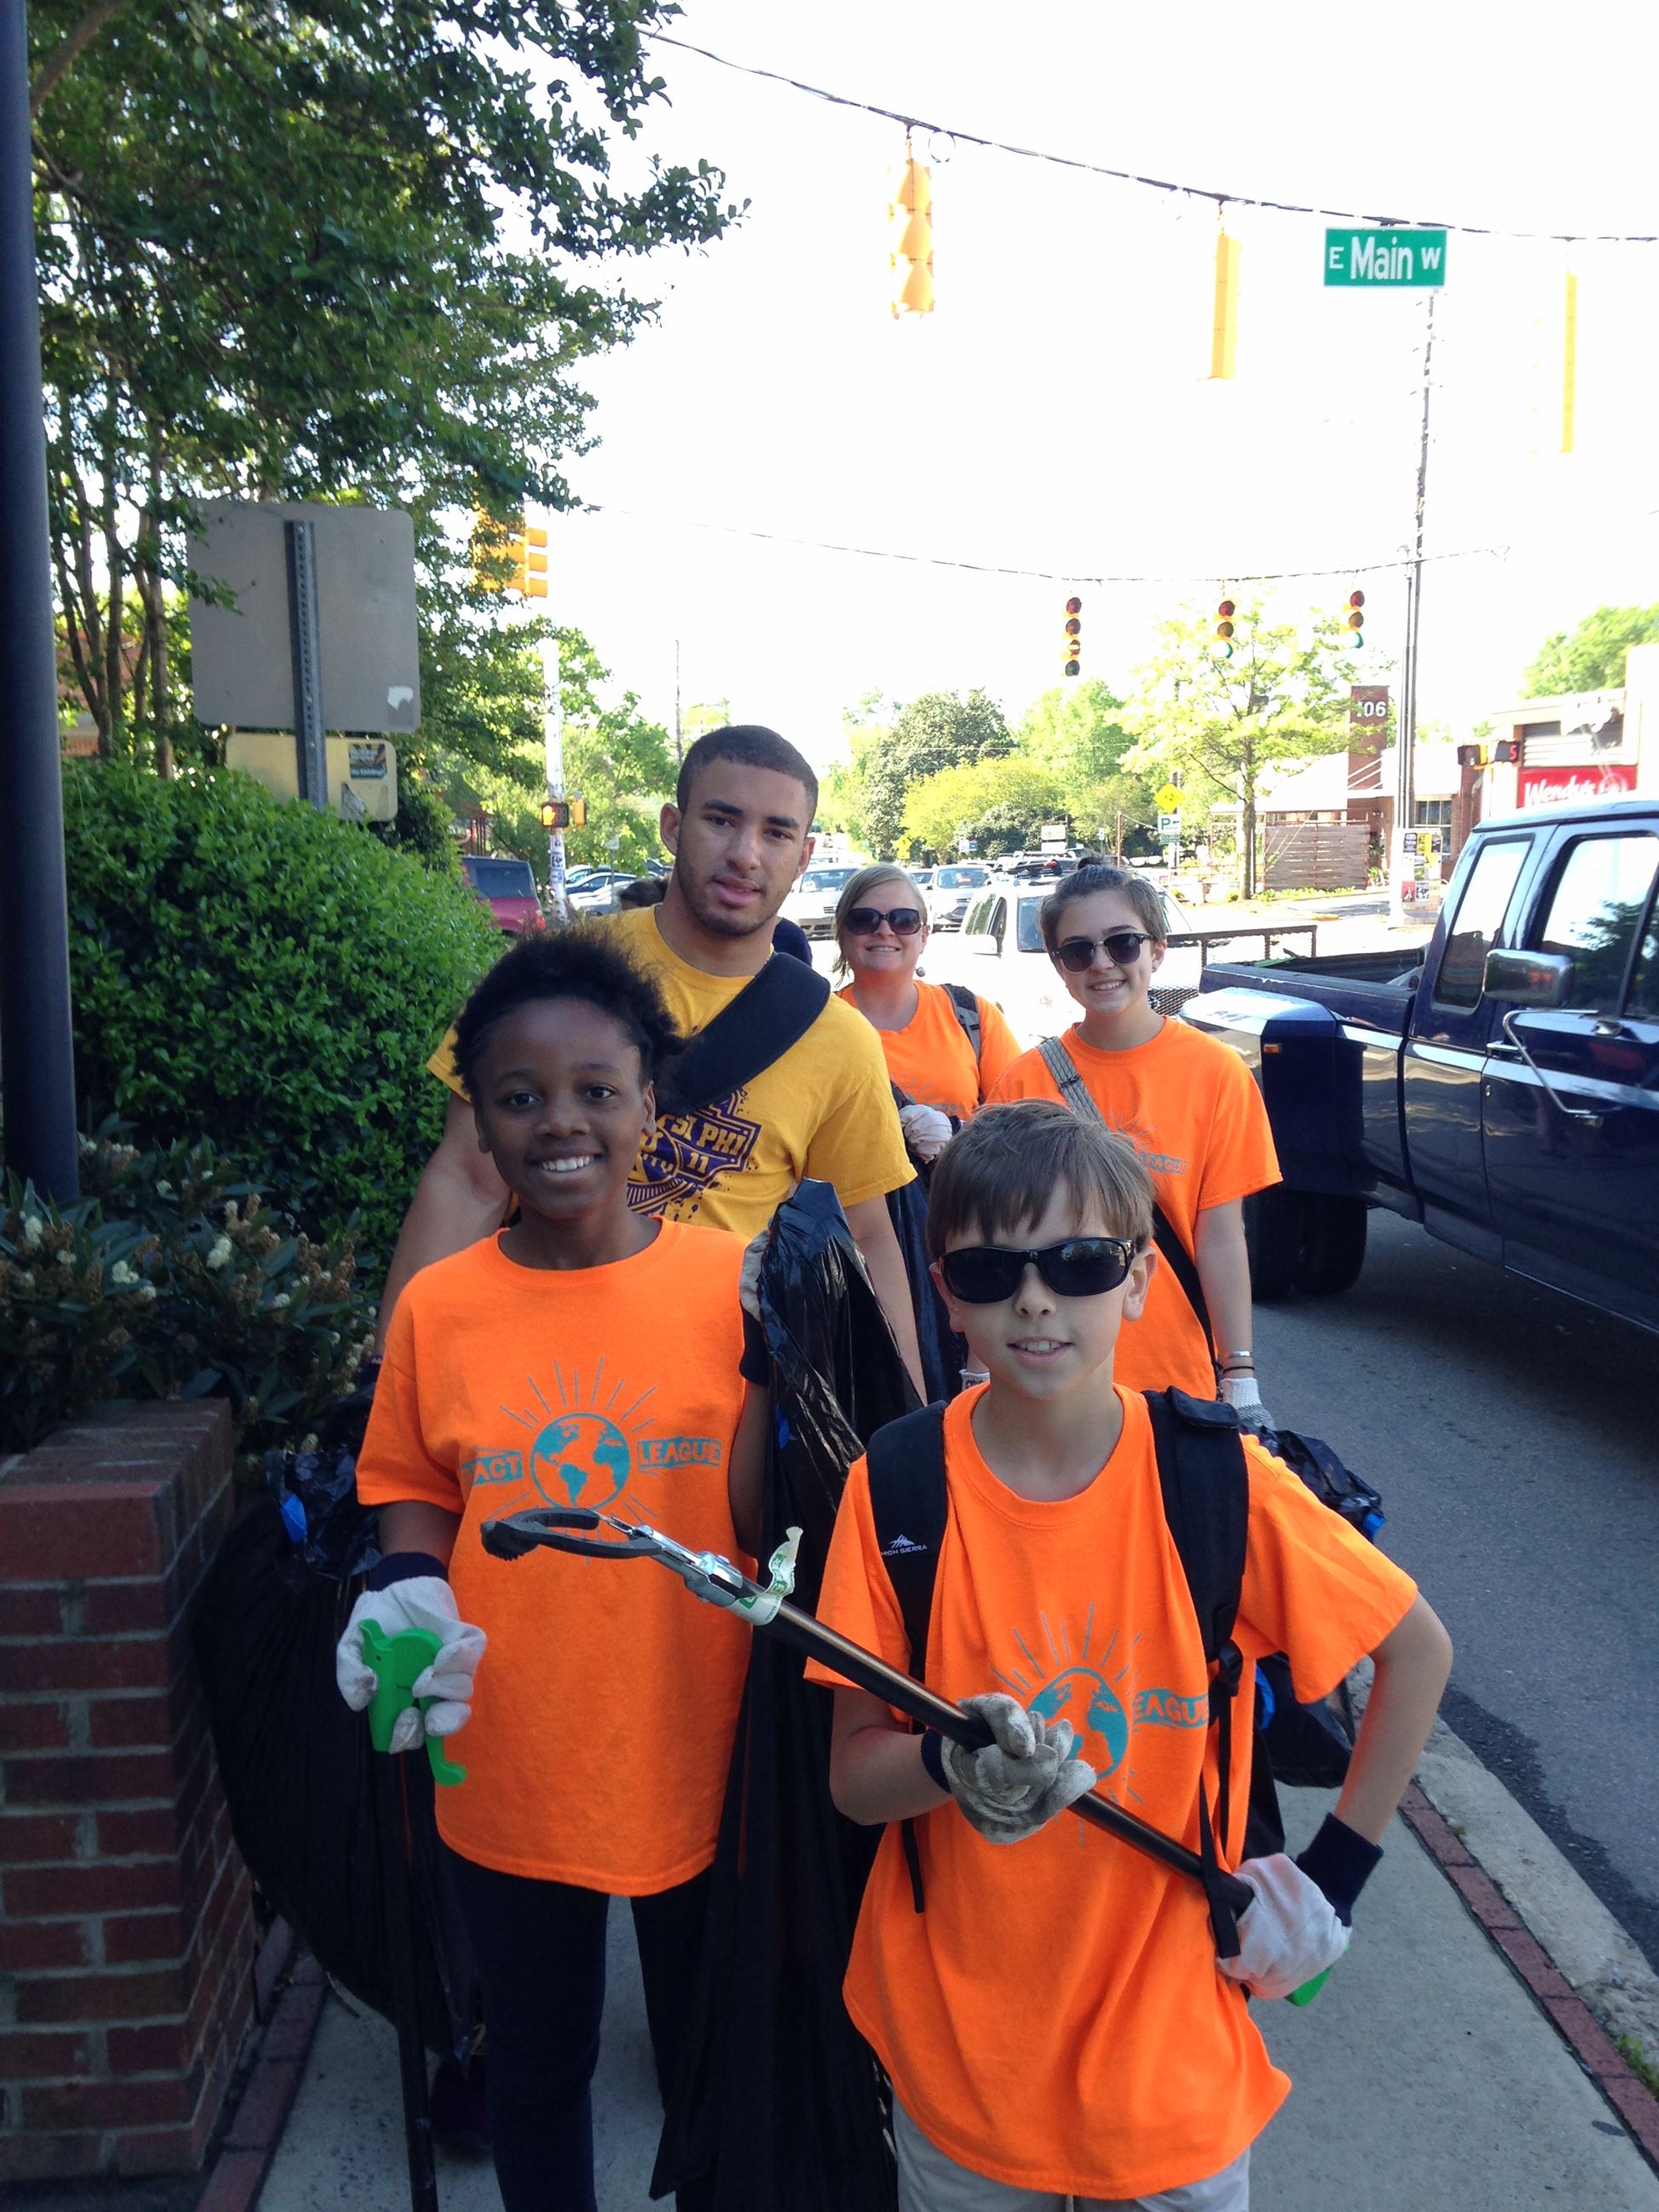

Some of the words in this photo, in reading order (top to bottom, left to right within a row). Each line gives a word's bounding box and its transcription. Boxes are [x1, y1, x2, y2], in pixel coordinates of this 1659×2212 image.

[1329, 247, 1344, 269] E
[1350, 236, 1413, 280] Main
[1421, 247, 1441, 270] W
[1161, 818, 1171, 830] P
[669, 1115, 697, 1141] SI
[696, 1122, 747, 1155] PHI
[1141, 1154, 1189, 1172] EAGUE
[639, 1440, 721, 1465] LEAGUE
[899, 1544, 927, 1554] SIERRA
[1132, 1693, 1208, 1725] EAGU
